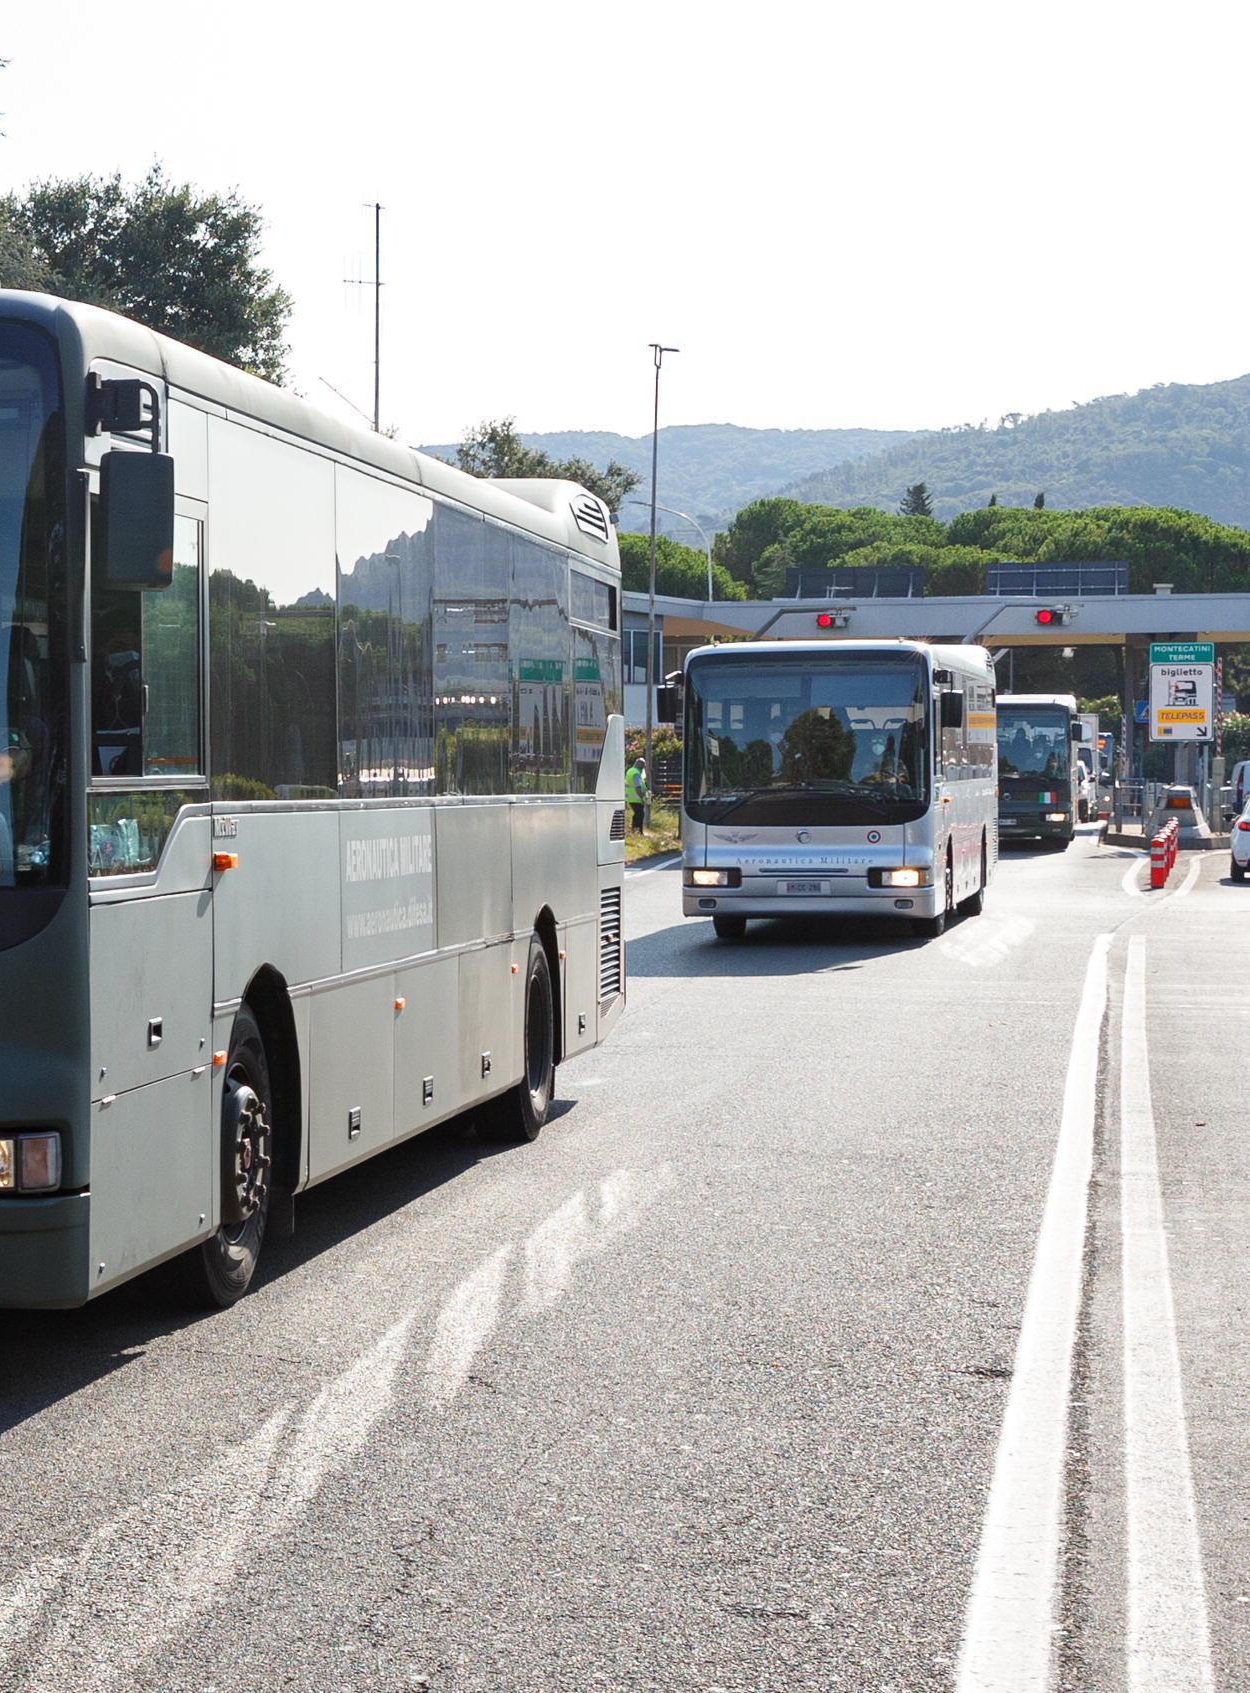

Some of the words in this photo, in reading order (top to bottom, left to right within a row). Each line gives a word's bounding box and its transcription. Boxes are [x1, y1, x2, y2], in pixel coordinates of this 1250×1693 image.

[1161, 668, 1203, 677] biglietto
[1161, 712, 1204, 720] TELEPASS
[346, 838, 400, 882] AERONAUTICA
[400, 835, 432, 876] MILITARE
